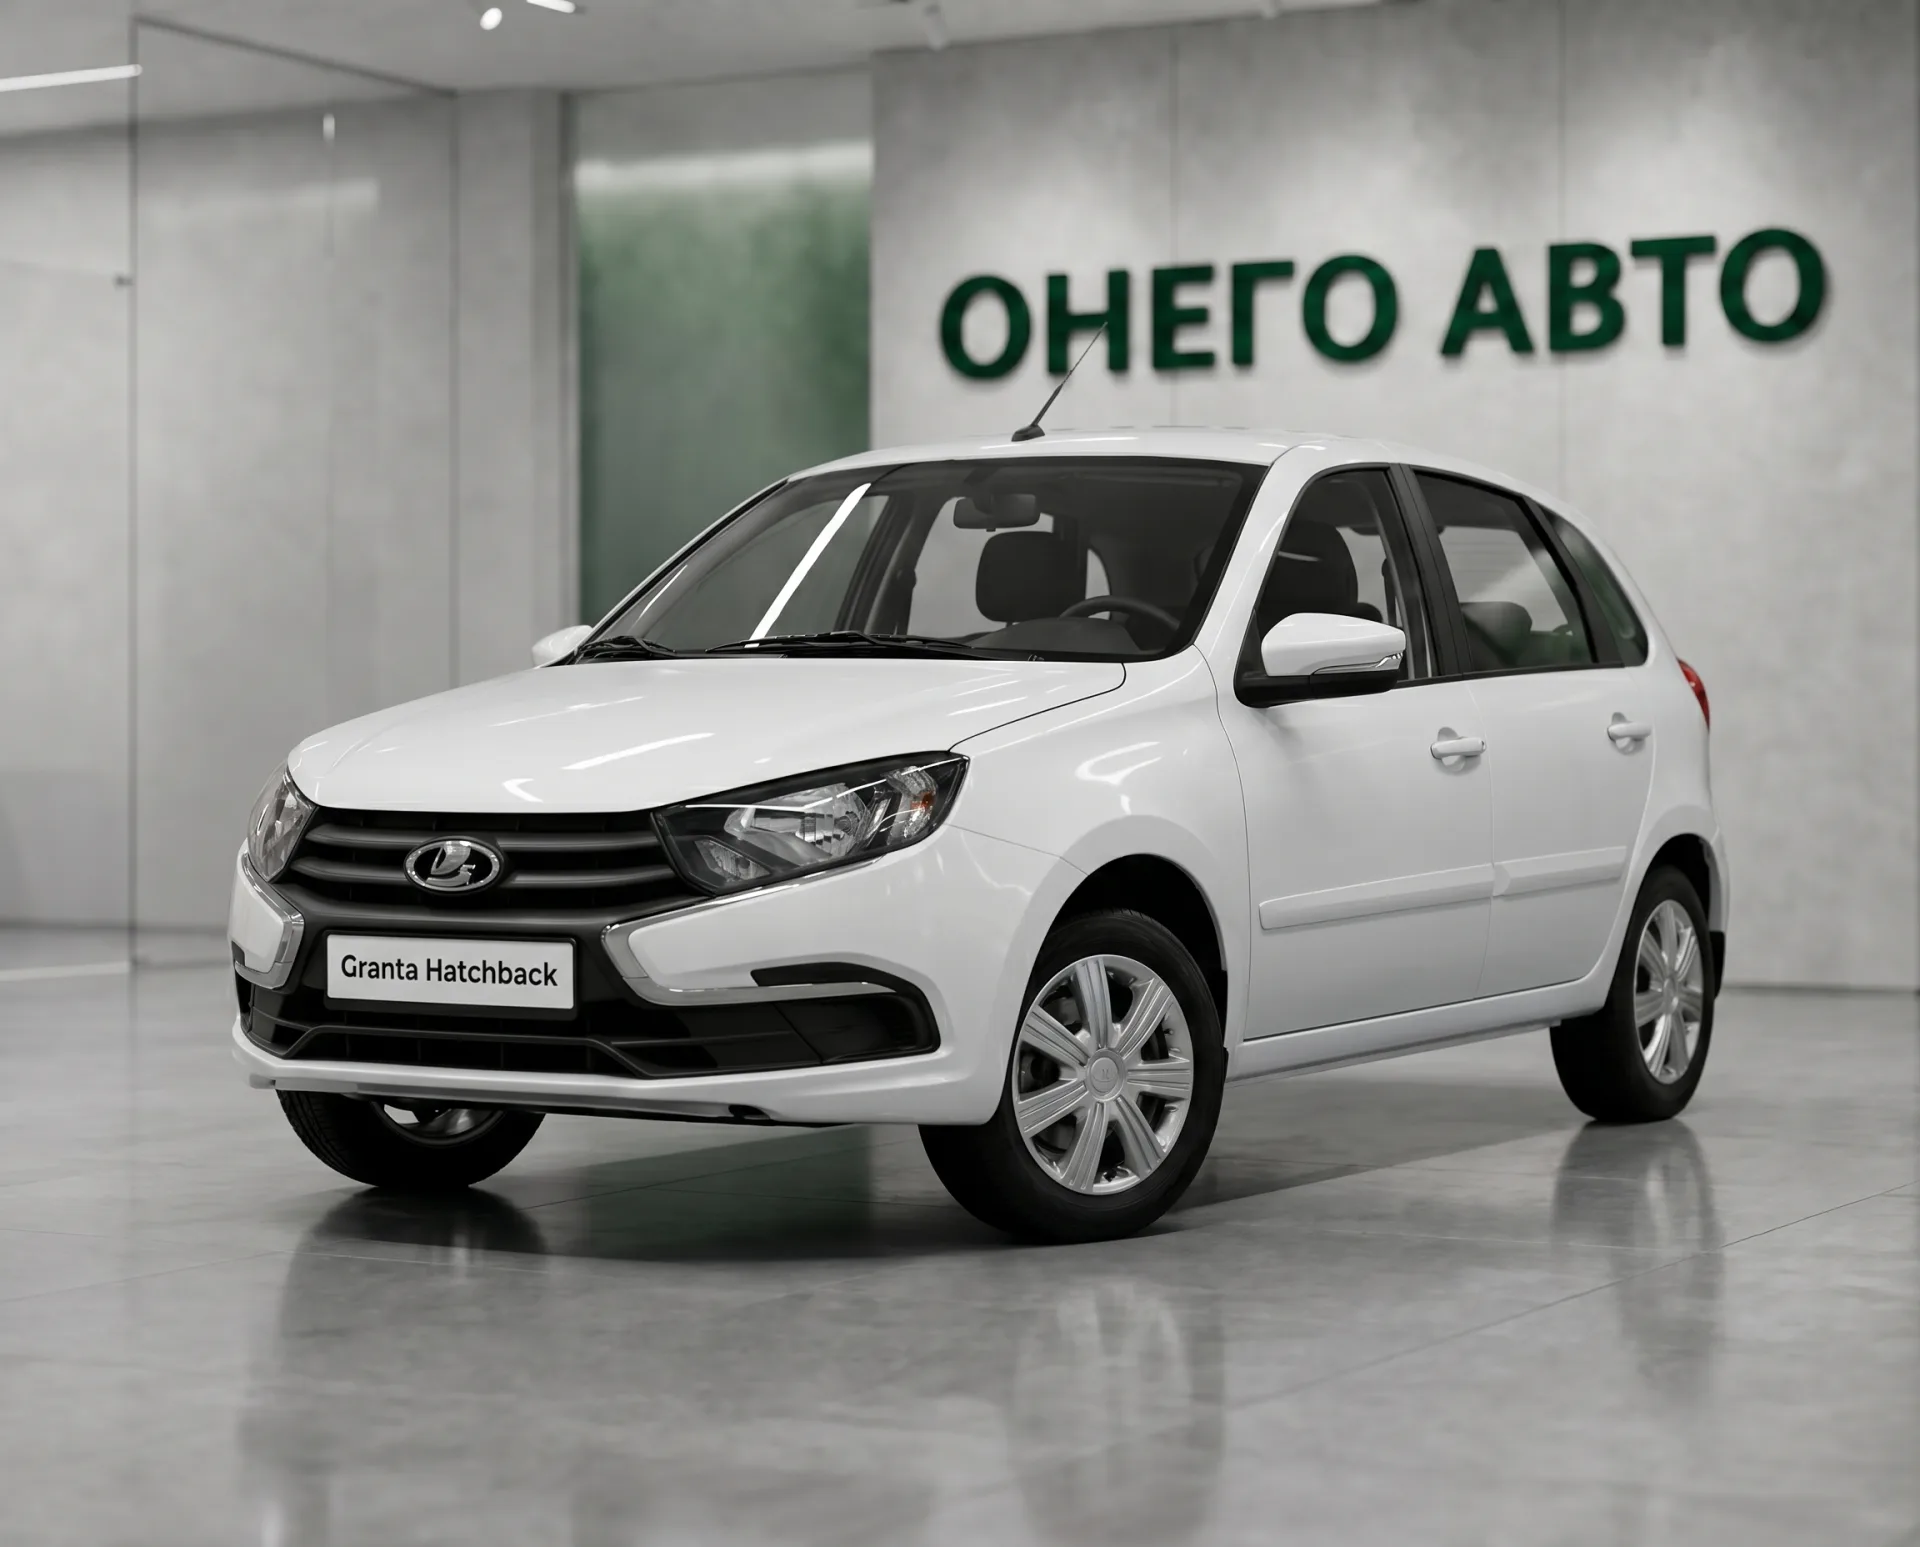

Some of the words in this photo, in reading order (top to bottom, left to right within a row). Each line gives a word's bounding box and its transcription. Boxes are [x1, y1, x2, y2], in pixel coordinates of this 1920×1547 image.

[939, 254, 1399, 379] ОНЕГО
[1441, 228, 1825, 357] АВТО
[341, 954, 418, 981] Granta
[426, 958, 558, 987] Hatchback
